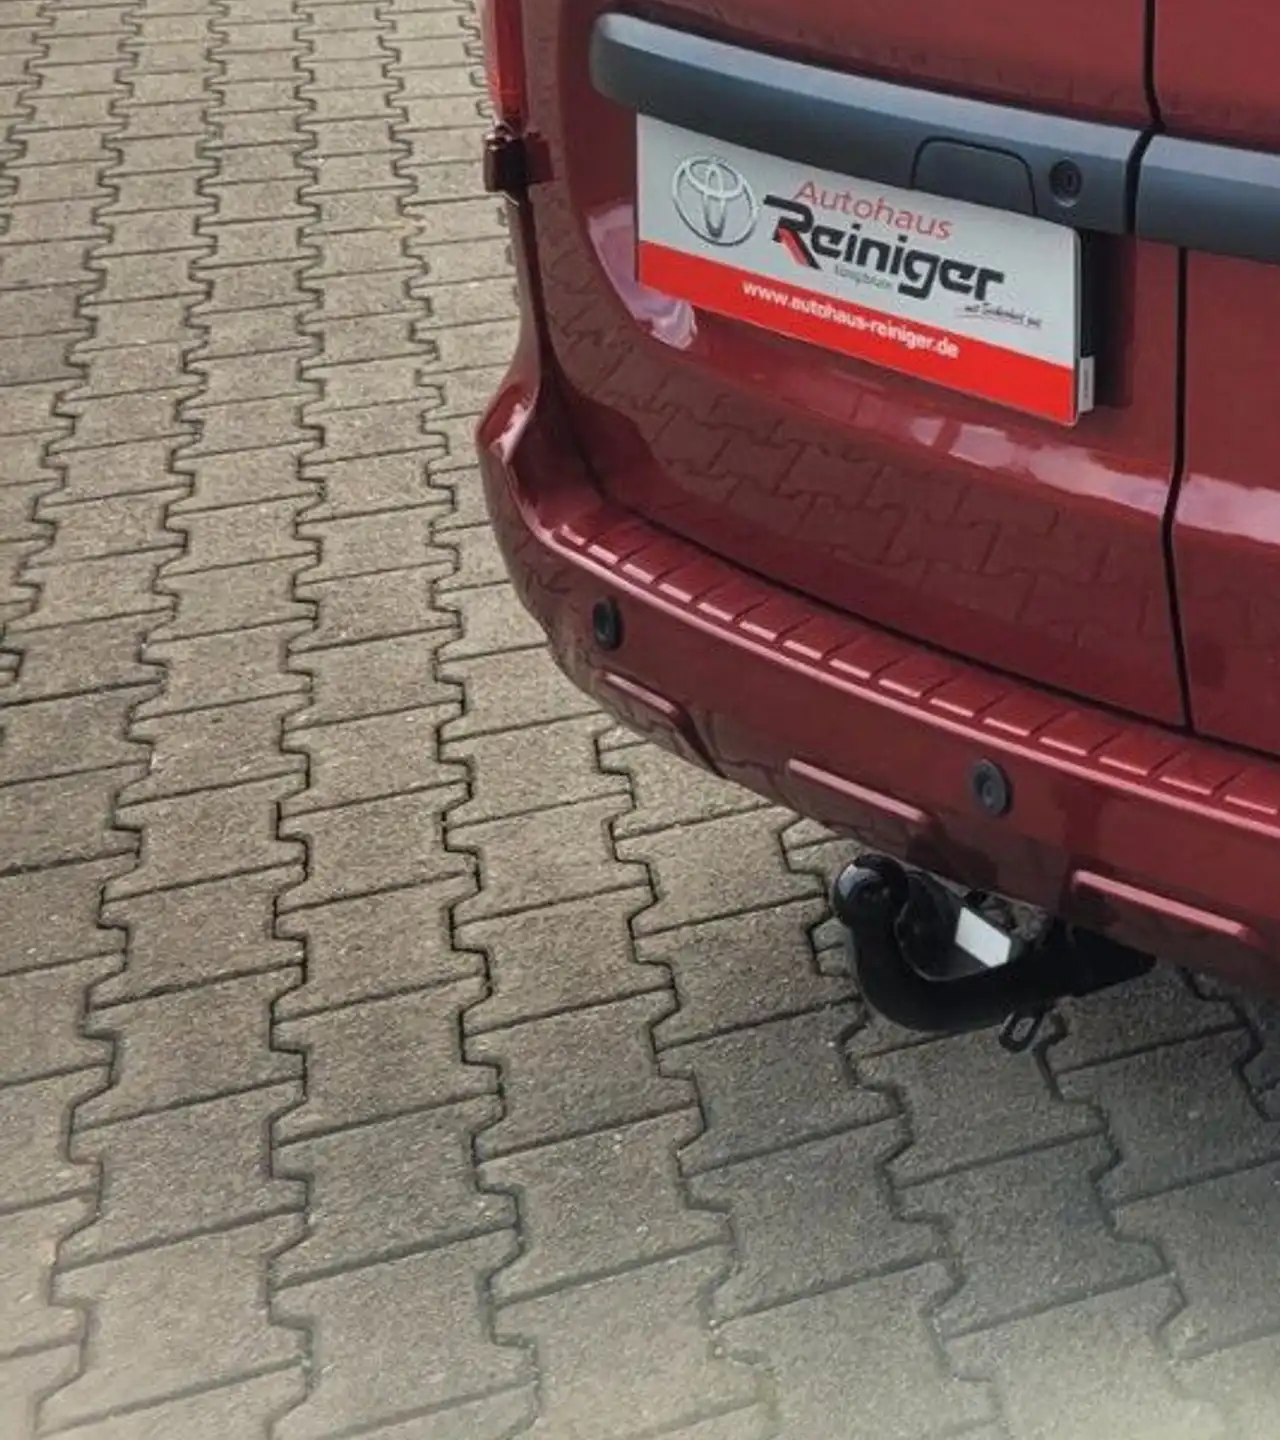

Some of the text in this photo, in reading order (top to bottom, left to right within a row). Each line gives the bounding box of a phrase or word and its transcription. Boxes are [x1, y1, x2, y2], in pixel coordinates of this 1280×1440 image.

[763, 194, 1005, 301] Reiniger
[795, 179, 954, 240] Autohaus
[741, 278, 959, 360] www.autohaus-reiniger.de
